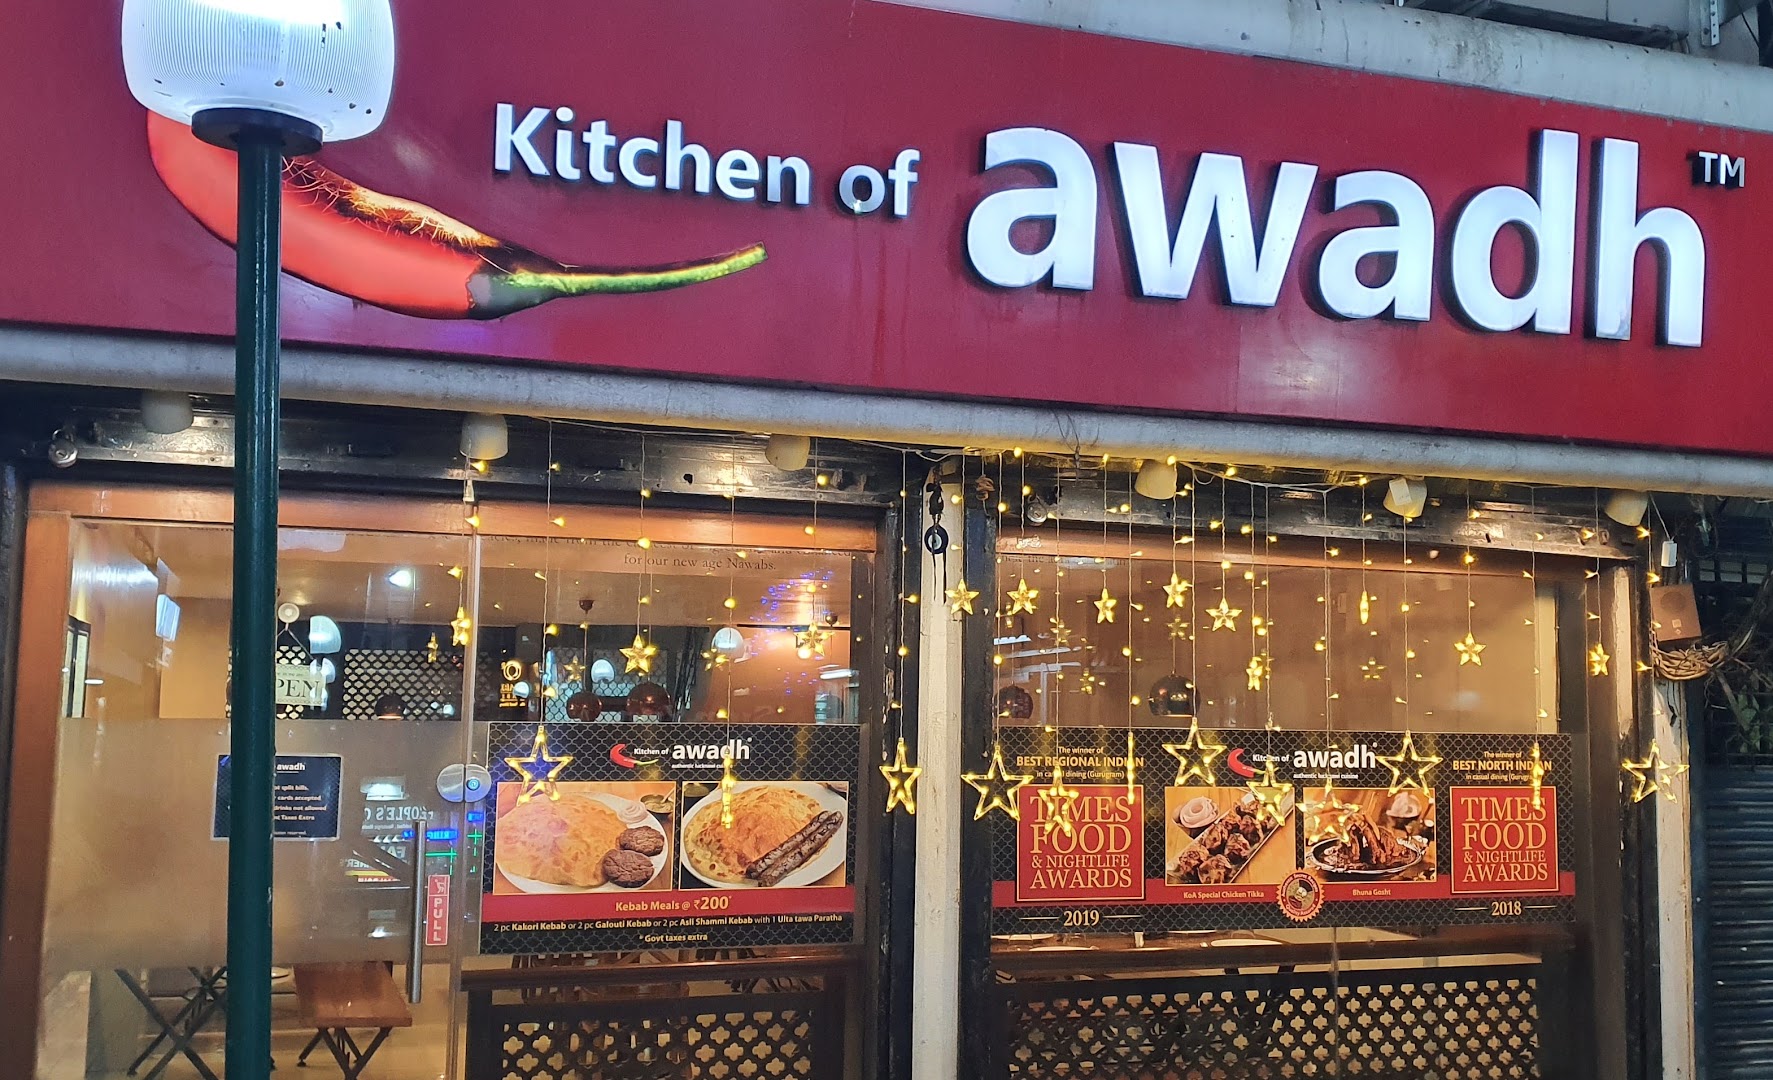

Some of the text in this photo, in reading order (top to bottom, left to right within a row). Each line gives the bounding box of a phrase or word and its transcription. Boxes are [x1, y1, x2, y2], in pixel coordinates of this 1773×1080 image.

[494, 103, 1746, 347] Kitchen of awadh TM
[624, 552, 776, 571] for our new age Nawabs.
[276, 679, 319, 697] PEN
[634, 739, 750, 760] Kitchen of awadh
[1058, 746, 1104, 754] The winner of
[1252, 744, 1376, 768] Kitcen of awadh
[1016, 756, 1144, 767] BEST REGIONAL INDIN
[1453, 760, 1552, 771] BEST NORTH INDAN
[1037, 770, 1125, 780] in cal dining (Gurugram)
[1490, 773, 1508, 781] dining
[1030, 796, 1132, 823] TIMES
[1460, 796, 1547, 822] TIMES
[1030, 824, 1132, 854] FOOD
[1461, 822, 1547, 850] FOOD
[1031, 854, 1130, 869] & NIGHTLIFE
[1463, 850, 1547, 864] & NIGHTLIFE
[1030, 868, 1132, 889] AWARDS
[1462, 863, 1548, 882] AWARDS
[1183, 891, 1197, 899] KoA
[1198, 891, 1220, 900] Special
[1247, 890, 1265, 898] Tikka
[615, 901, 648, 912] Kebab
[650, 900, 680, 911] Meals
[681, 902, 691, 911] @
[1491, 900, 1522, 916] 2018
[433, 898, 443, 941] PULL
[494, 924, 499, 932] 2
[500, 925, 511, 933] pc
[511, 922, 539, 931] Kakori
[540, 922, 567, 931] Kebab
[578, 922, 583, 930] 2
[584, 923, 594, 931] pc
[595, 920, 625, 930] Galouti
[626, 920, 652, 929] Kebab
[663, 919, 668, 928] 2
[669, 920, 678, 928] pc
[680, 917, 694, 926] Asli
[695, 917, 728, 926] Shammi
[728, 916, 753, 925] Kebab
[754, 916, 770, 924] with
[777, 915, 793, 923] Ulta
[795, 915, 813, 923] tawa
[813, 914, 843, 922] Paratha
[1063, 909, 1100, 927] 2019
[665, 934, 686, 942] taxes
[688, 933, 708, 941] extra
